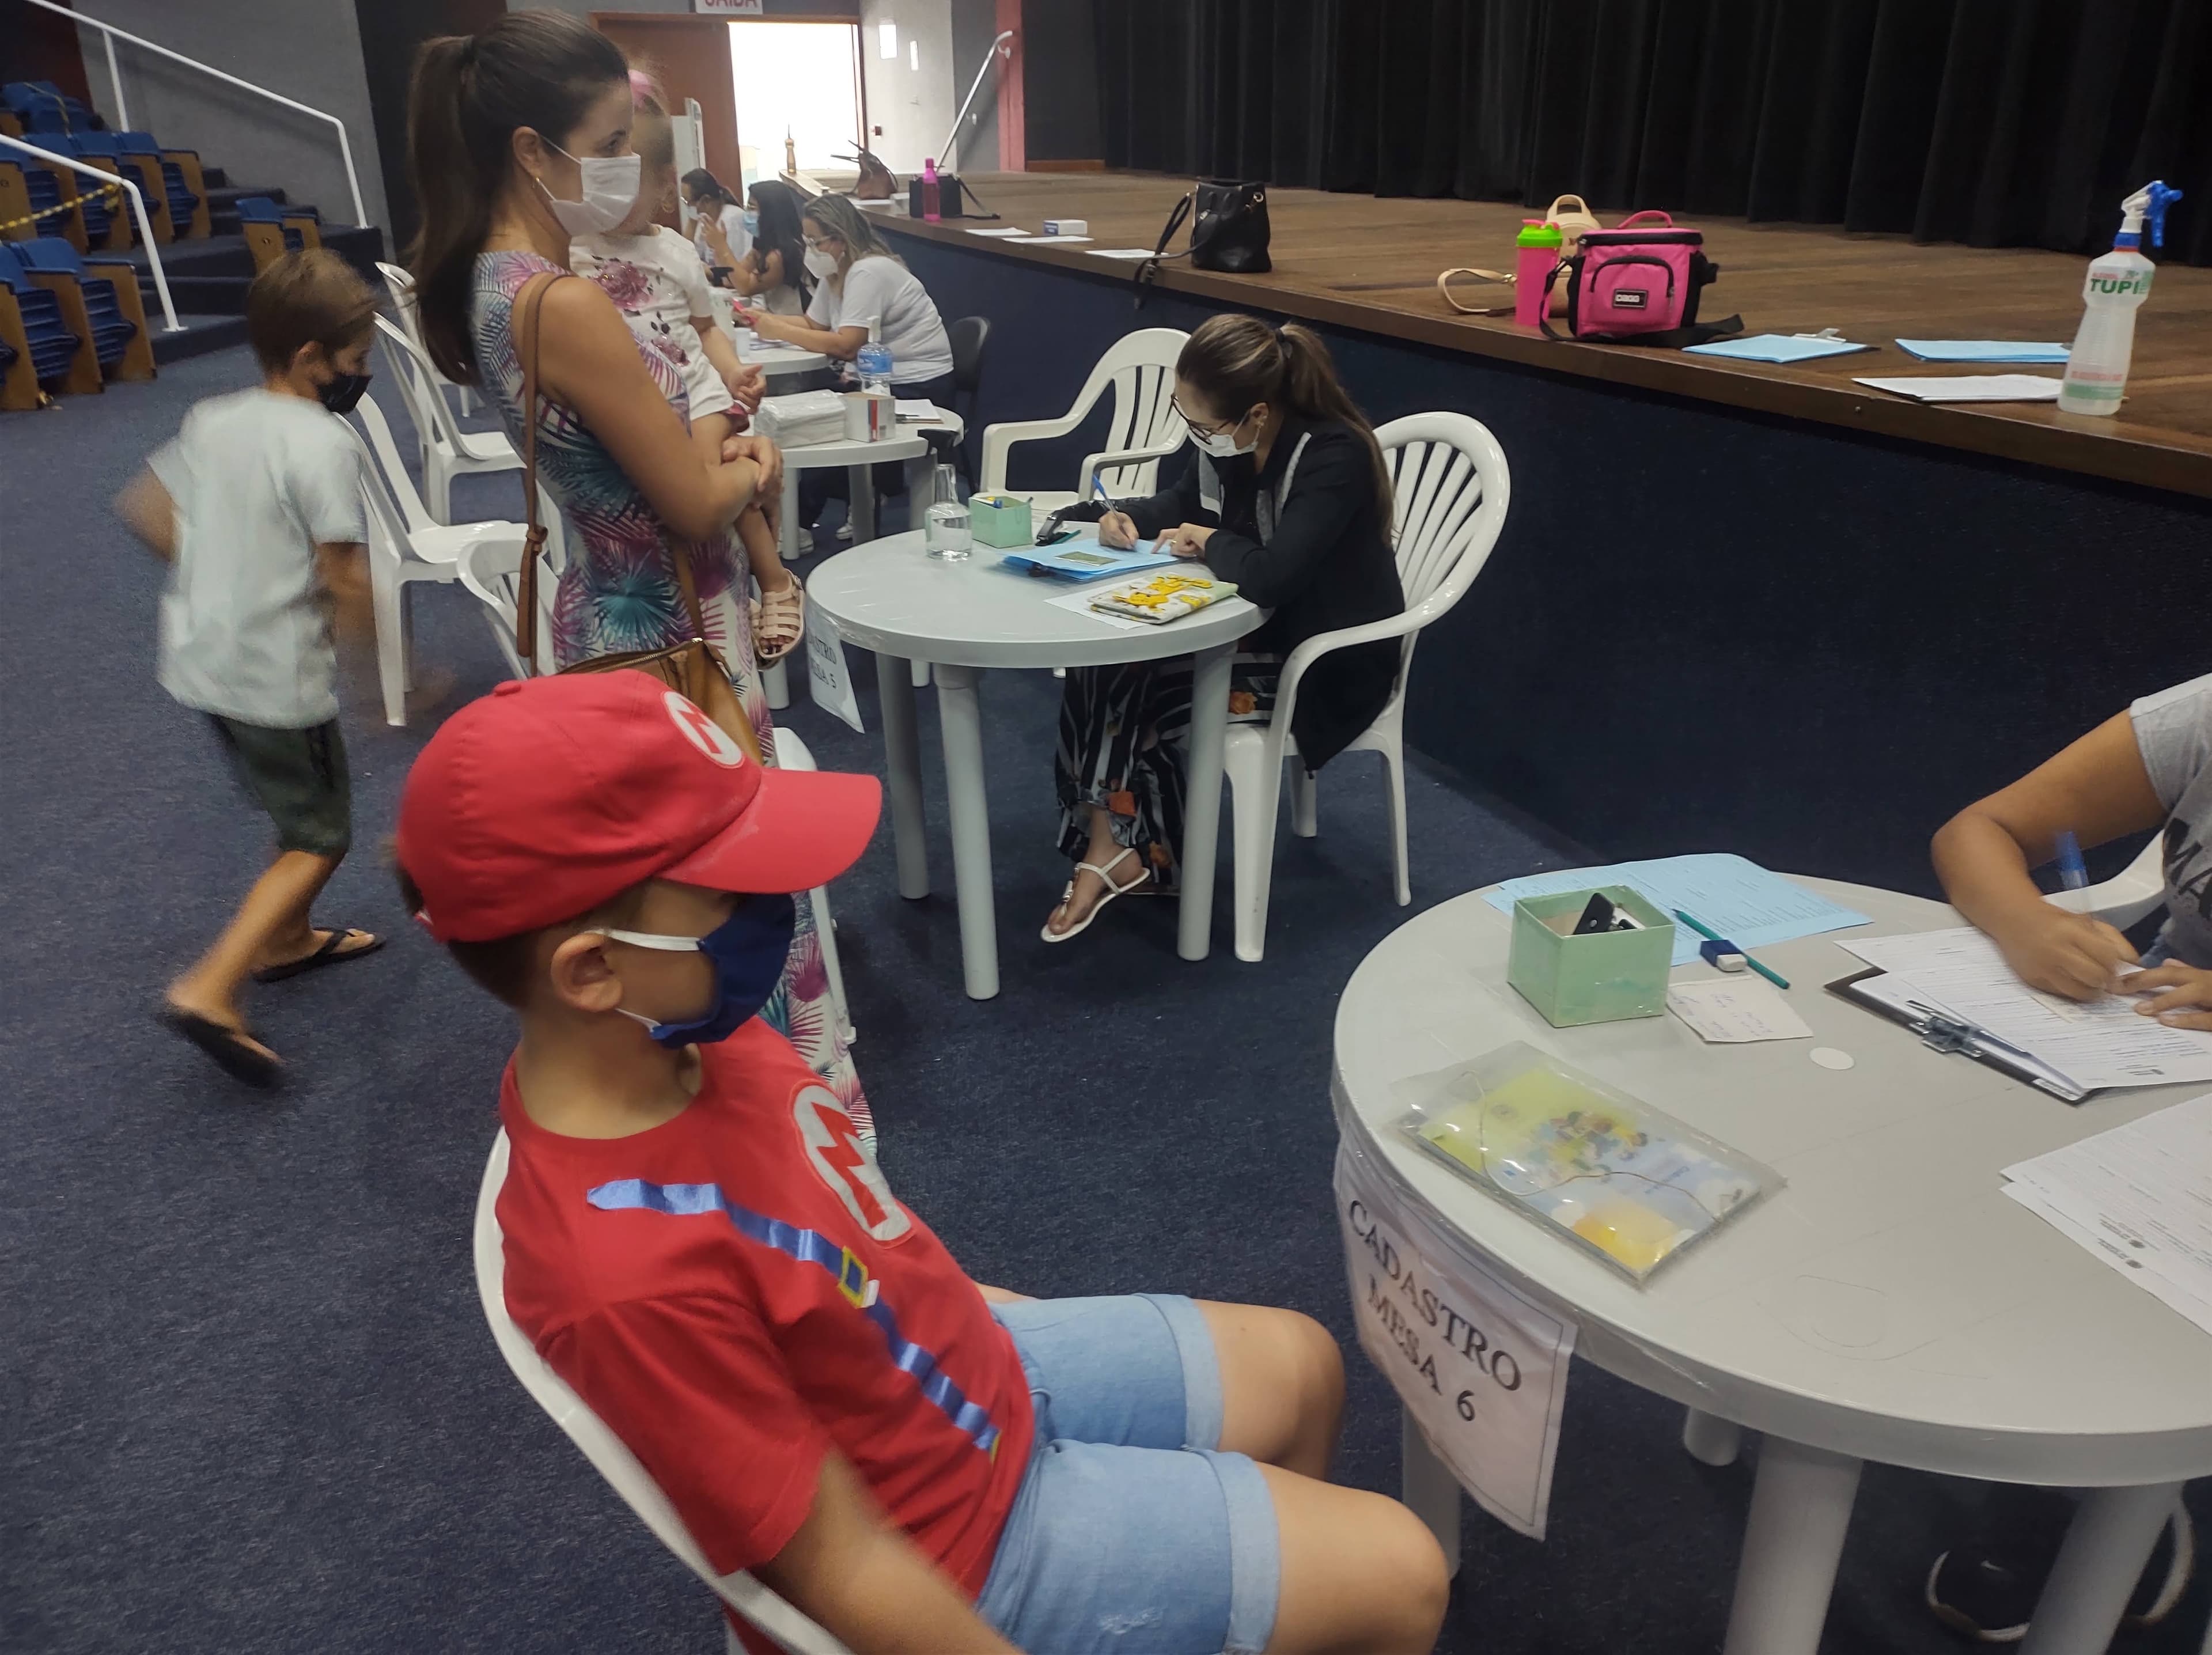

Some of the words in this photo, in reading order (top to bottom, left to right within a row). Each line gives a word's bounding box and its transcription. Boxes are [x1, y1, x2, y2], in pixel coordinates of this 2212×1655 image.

[2090, 278, 2139, 294] TUPI
[1349, 1199, 1521, 1392] CADASTRO
[1367, 1273, 1442, 1396] MESA
[1457, 1389, 1475, 1422] 6
